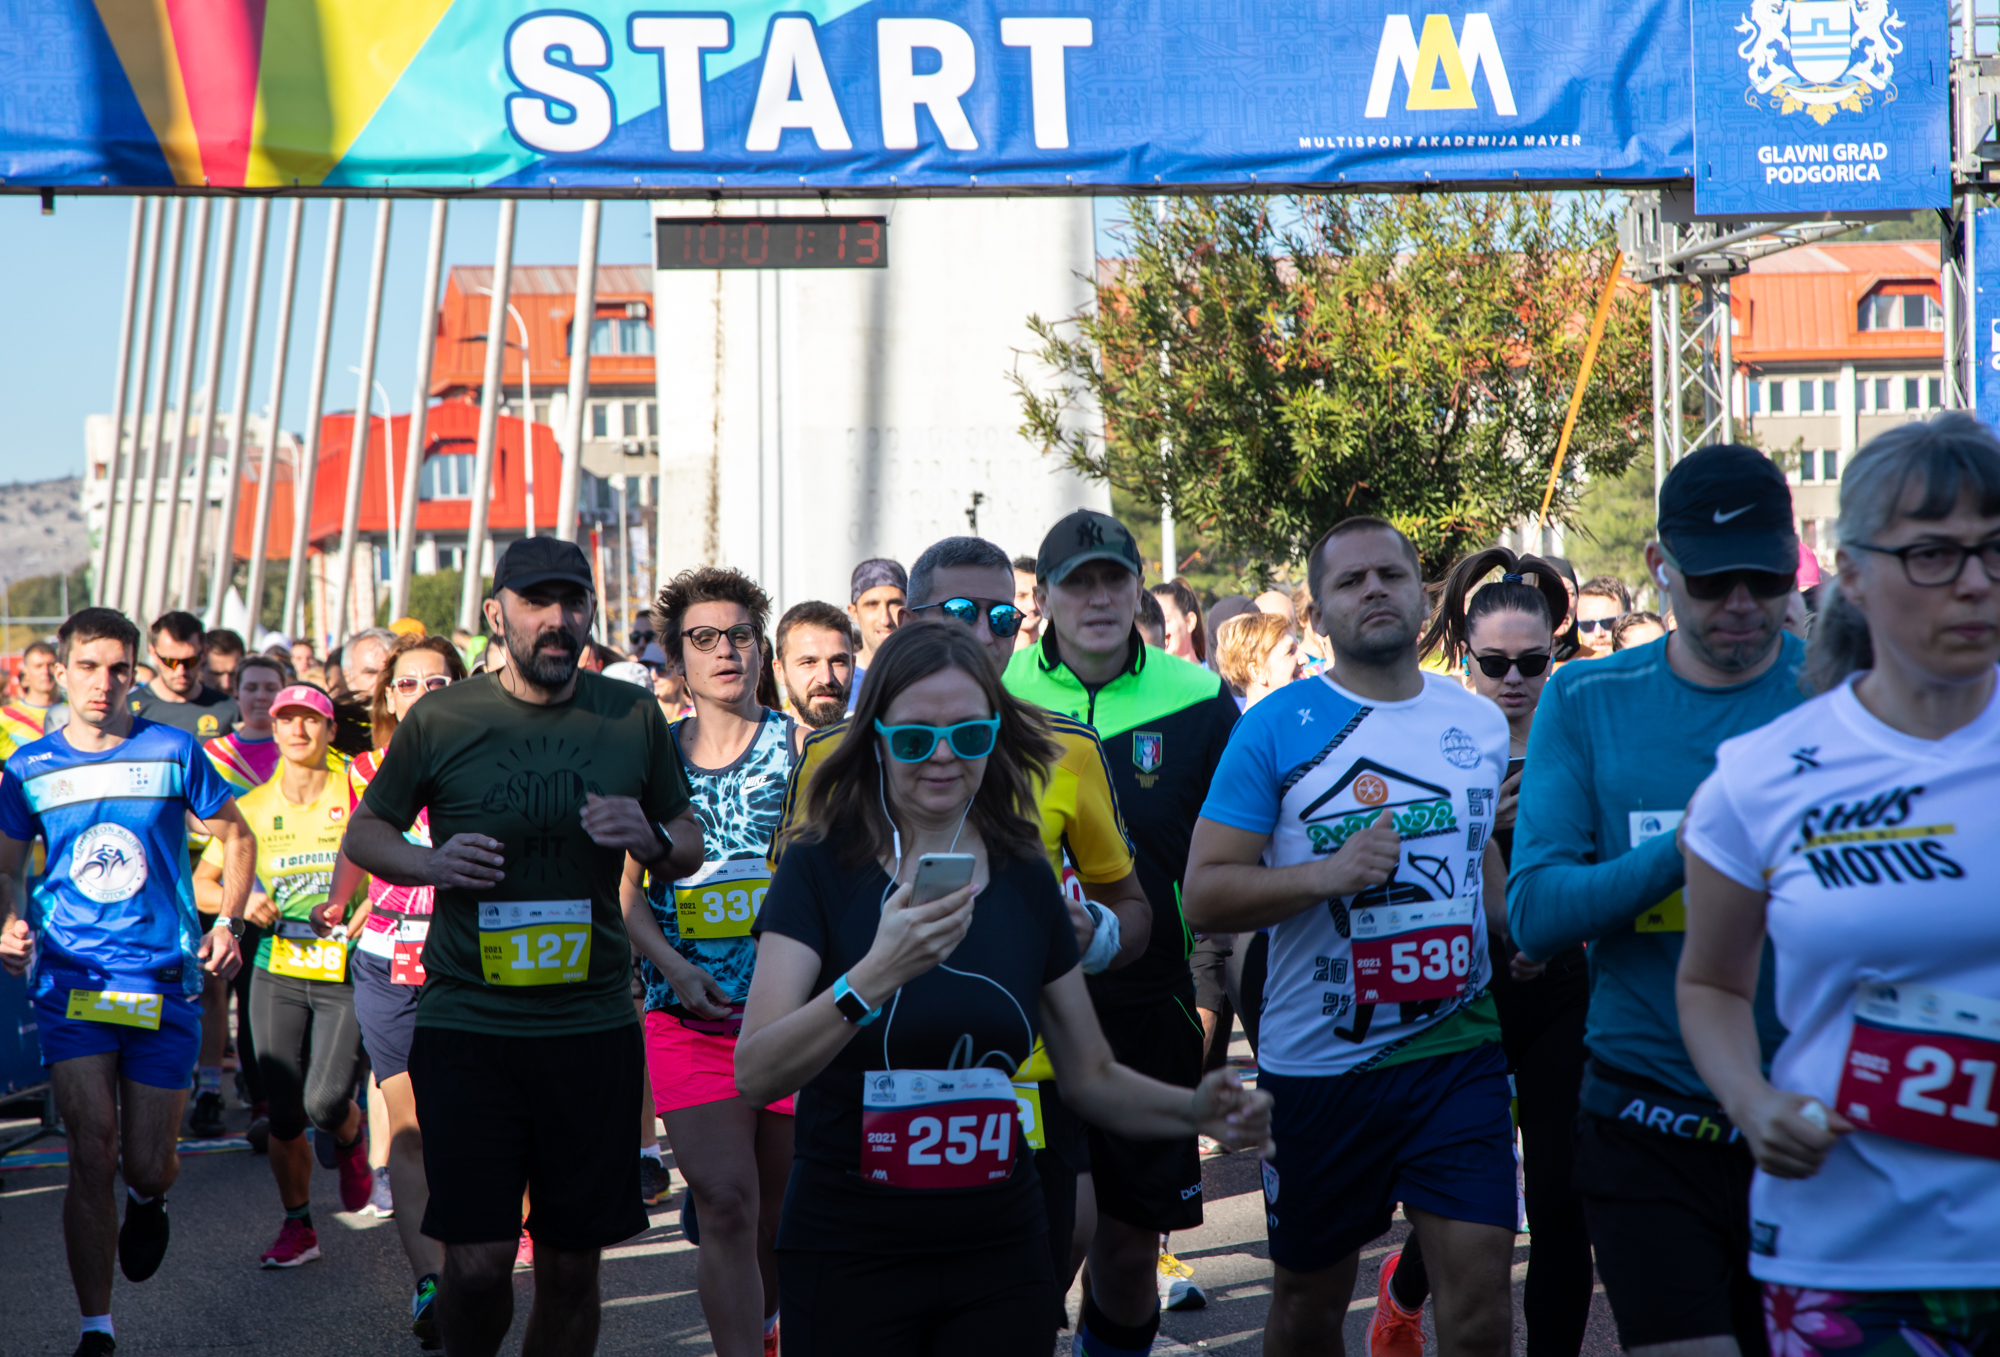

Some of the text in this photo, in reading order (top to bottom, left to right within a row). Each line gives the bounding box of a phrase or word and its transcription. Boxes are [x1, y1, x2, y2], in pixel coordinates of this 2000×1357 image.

[507, 13, 1095, 153] START
[1299, 134, 1582, 148] MULTISPORT AKADEMIJA MAYER
[1757, 143, 1888, 164] GLAVNI GRAD
[1765, 162, 1881, 185] PODGORICA
[745, 775, 768, 788] NIKE
[508, 770, 584, 833] SOUL
[524, 836, 567, 858] FIT
[1804, 840, 1967, 889] MOTUS
[679, 902, 697, 910] 2021
[288, 944, 342, 971] 136
[484, 945, 502, 954] 2021
[511, 931, 587, 969] 127
[1391, 935, 1470, 984] 538
[1357, 957, 1382, 968] 2021
[94, 990, 159, 1018] 142
[1618, 1098, 1721, 1142] ARCh
[867, 1132, 897, 1144] 2021
[908, 1112, 1011, 1166] 254
